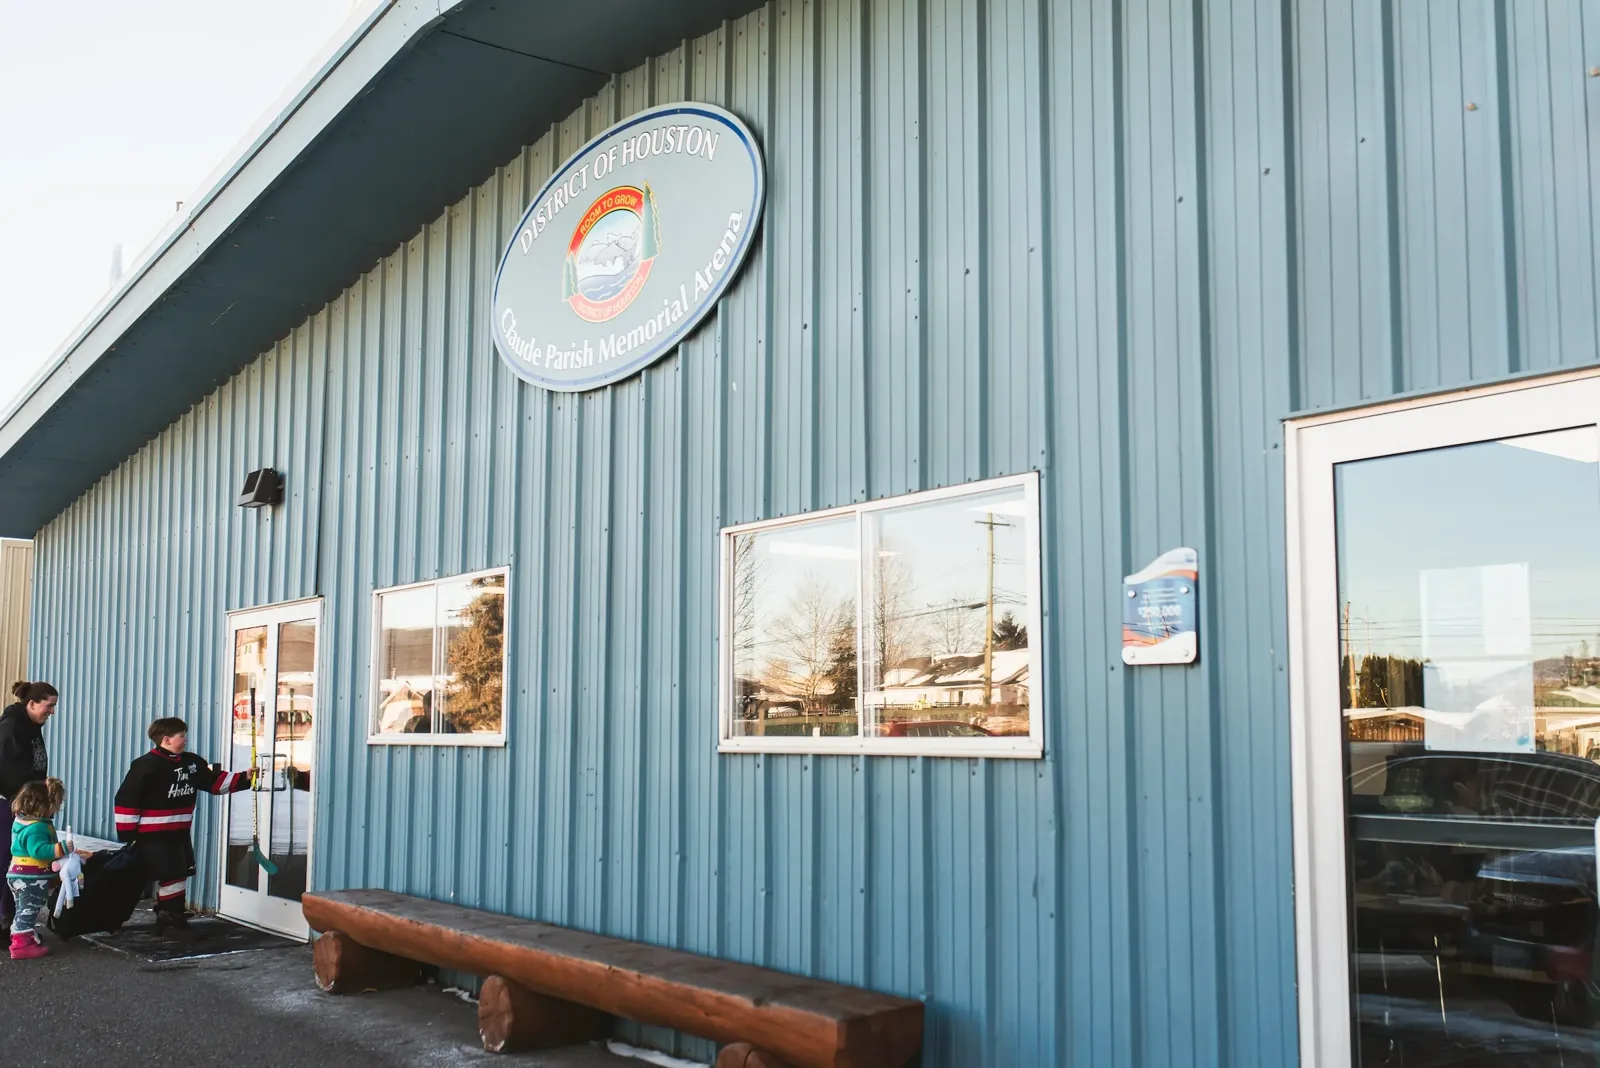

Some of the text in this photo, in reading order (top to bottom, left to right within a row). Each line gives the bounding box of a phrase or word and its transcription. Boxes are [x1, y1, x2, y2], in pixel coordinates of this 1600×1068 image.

[519, 125, 720, 256] DISTRICT OF HOUSTON
[580, 193, 638, 235] ROOM TO GROW
[501, 209, 744, 371] Claude Parish Memorial Arena
[173, 767, 189, 782] Tim
